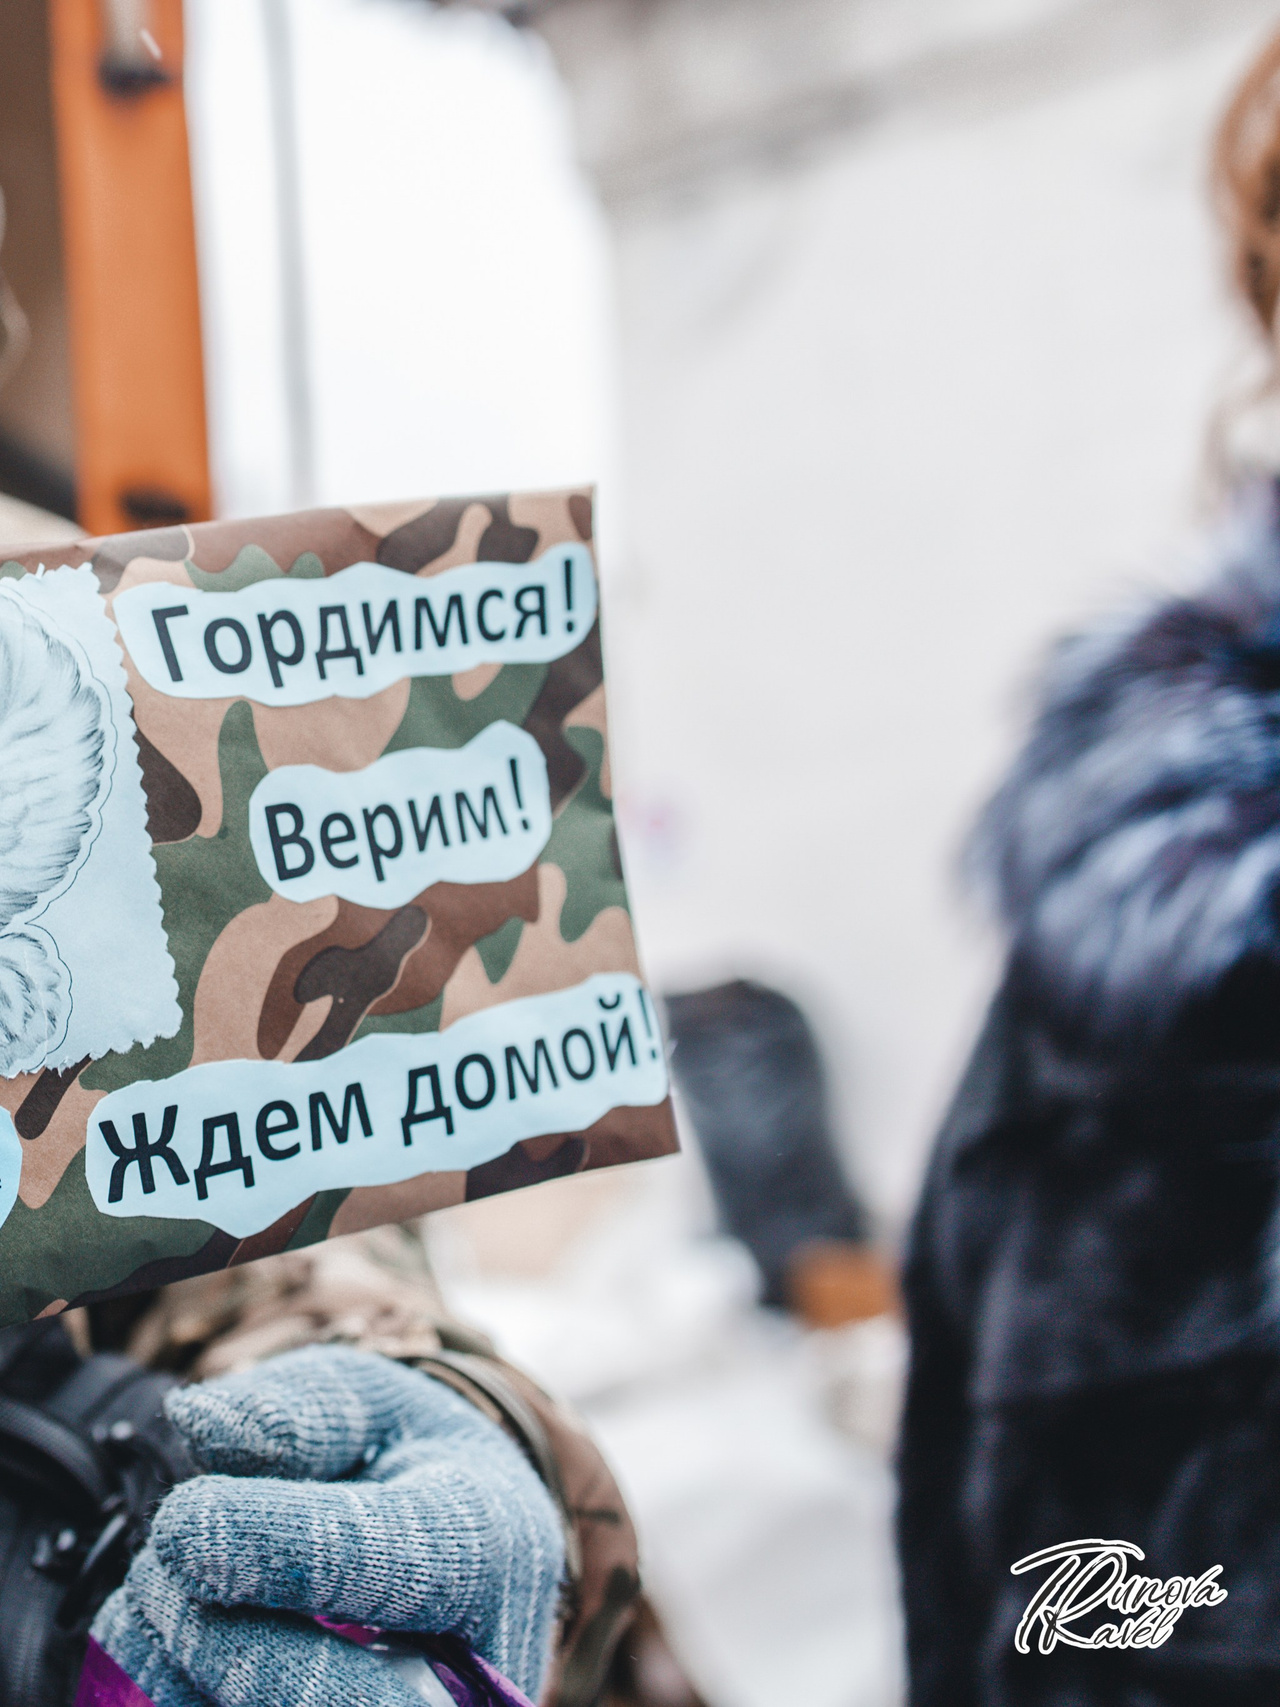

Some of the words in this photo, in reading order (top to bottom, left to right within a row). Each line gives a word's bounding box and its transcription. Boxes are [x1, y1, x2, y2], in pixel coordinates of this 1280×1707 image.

[151, 557, 576, 689] Гордимся!
[264, 757, 533, 882] Верим!
[98, 1081, 375, 1204] Ждем
[400, 988, 658, 1146] домой!
